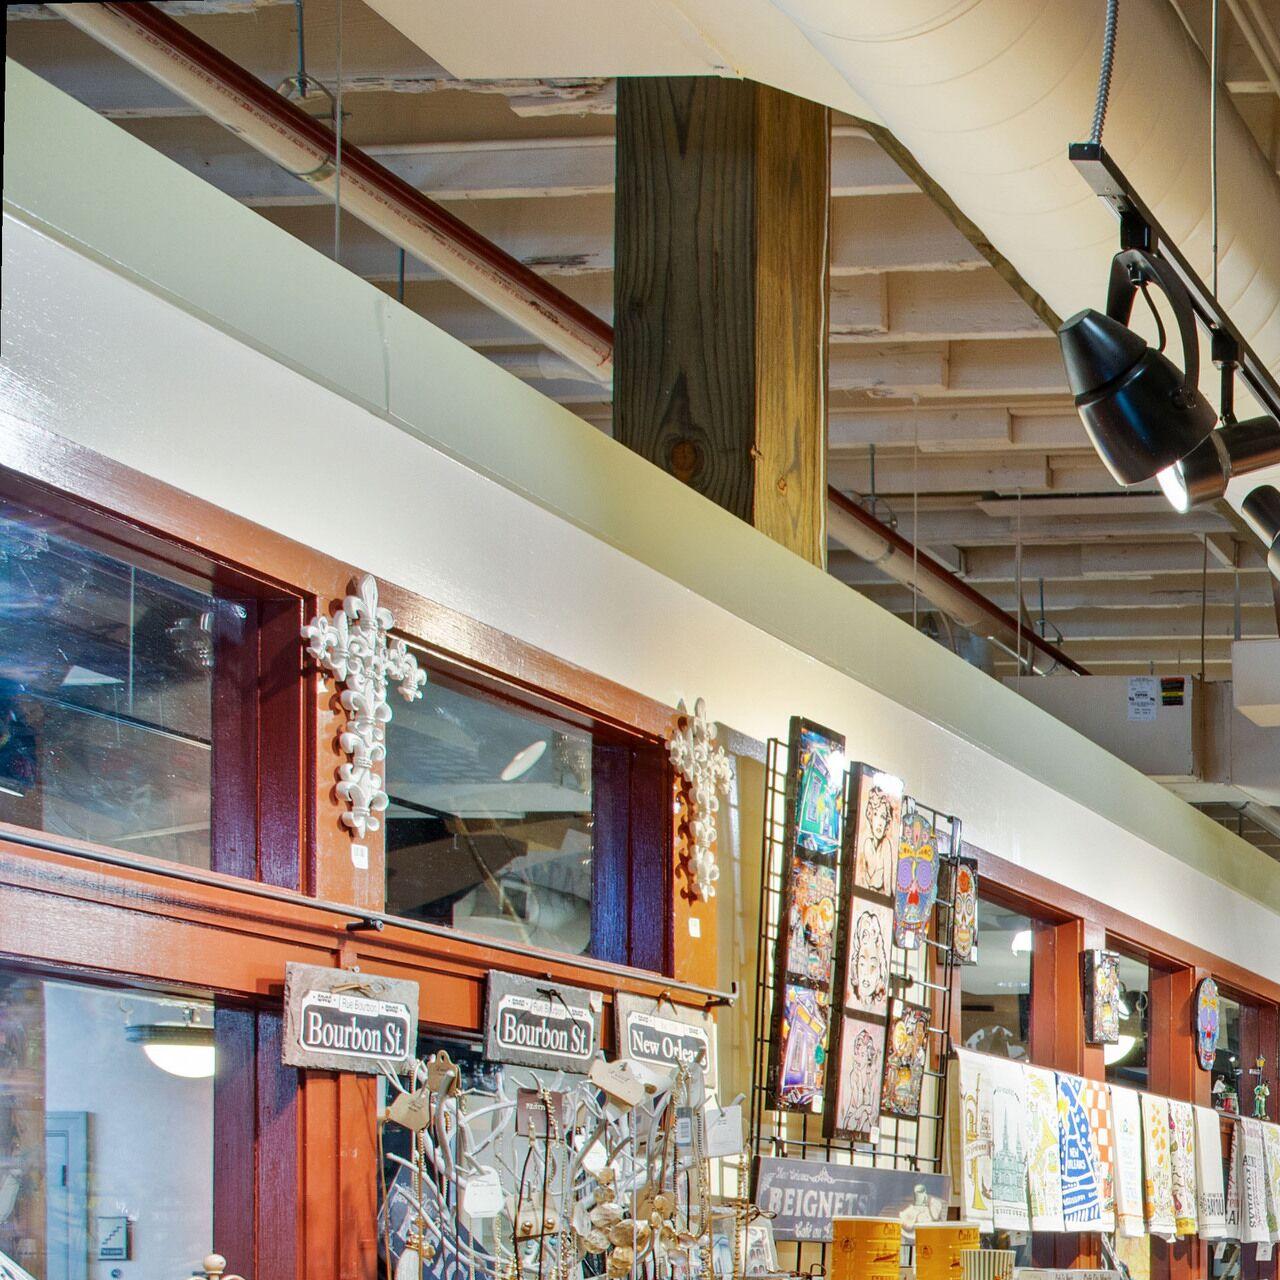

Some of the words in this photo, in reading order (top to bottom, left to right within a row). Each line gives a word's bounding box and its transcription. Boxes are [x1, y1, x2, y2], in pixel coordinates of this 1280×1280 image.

[307, 1011, 382, 1053] Bourbon
[385, 1022, 405, 1056] St.
[502, 1013, 568, 1051] Bourbon
[570, 1023, 589, 1055] St.
[632, 1029, 660, 1057] New
[662, 1037, 708, 1066] Orleas
[769, 1186, 869, 1218] BEIGNETS
